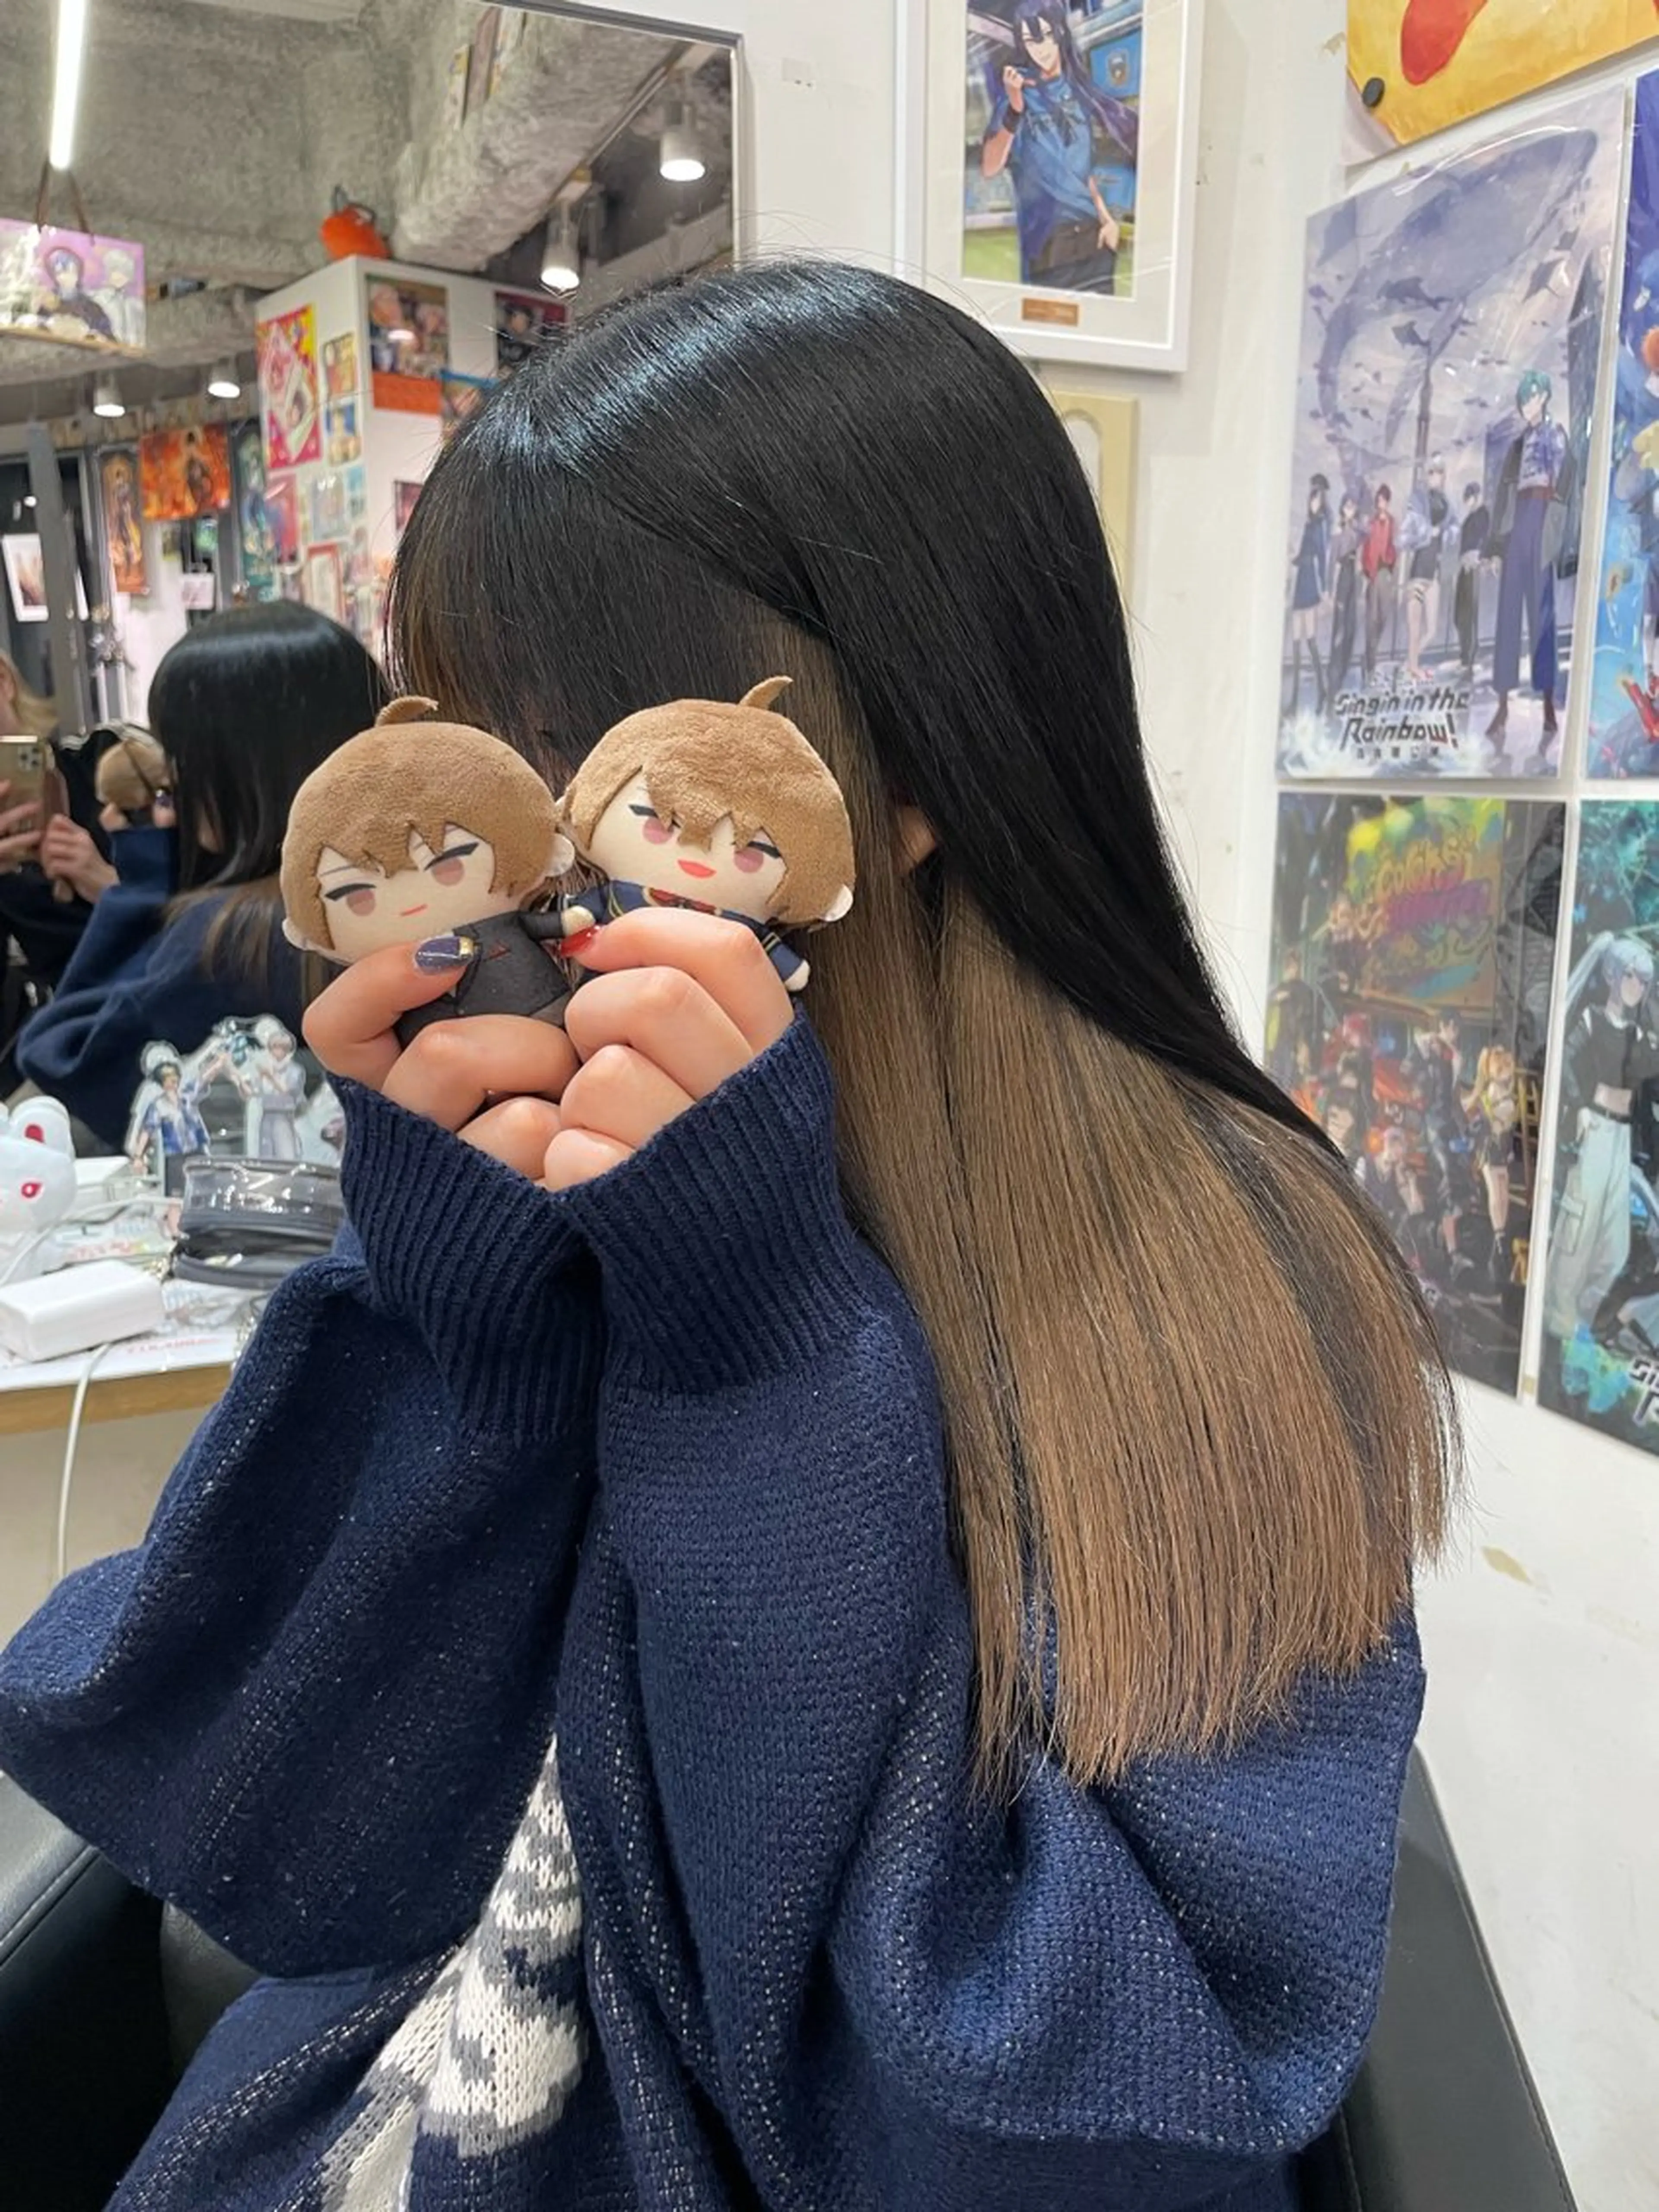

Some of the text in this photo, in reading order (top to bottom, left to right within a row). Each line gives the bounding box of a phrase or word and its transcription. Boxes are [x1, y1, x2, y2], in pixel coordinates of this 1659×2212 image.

[1404, 689, 1425, 712] in
[1429, 686, 1470, 711] the
[1340, 712, 1459, 750] Rainbow!
